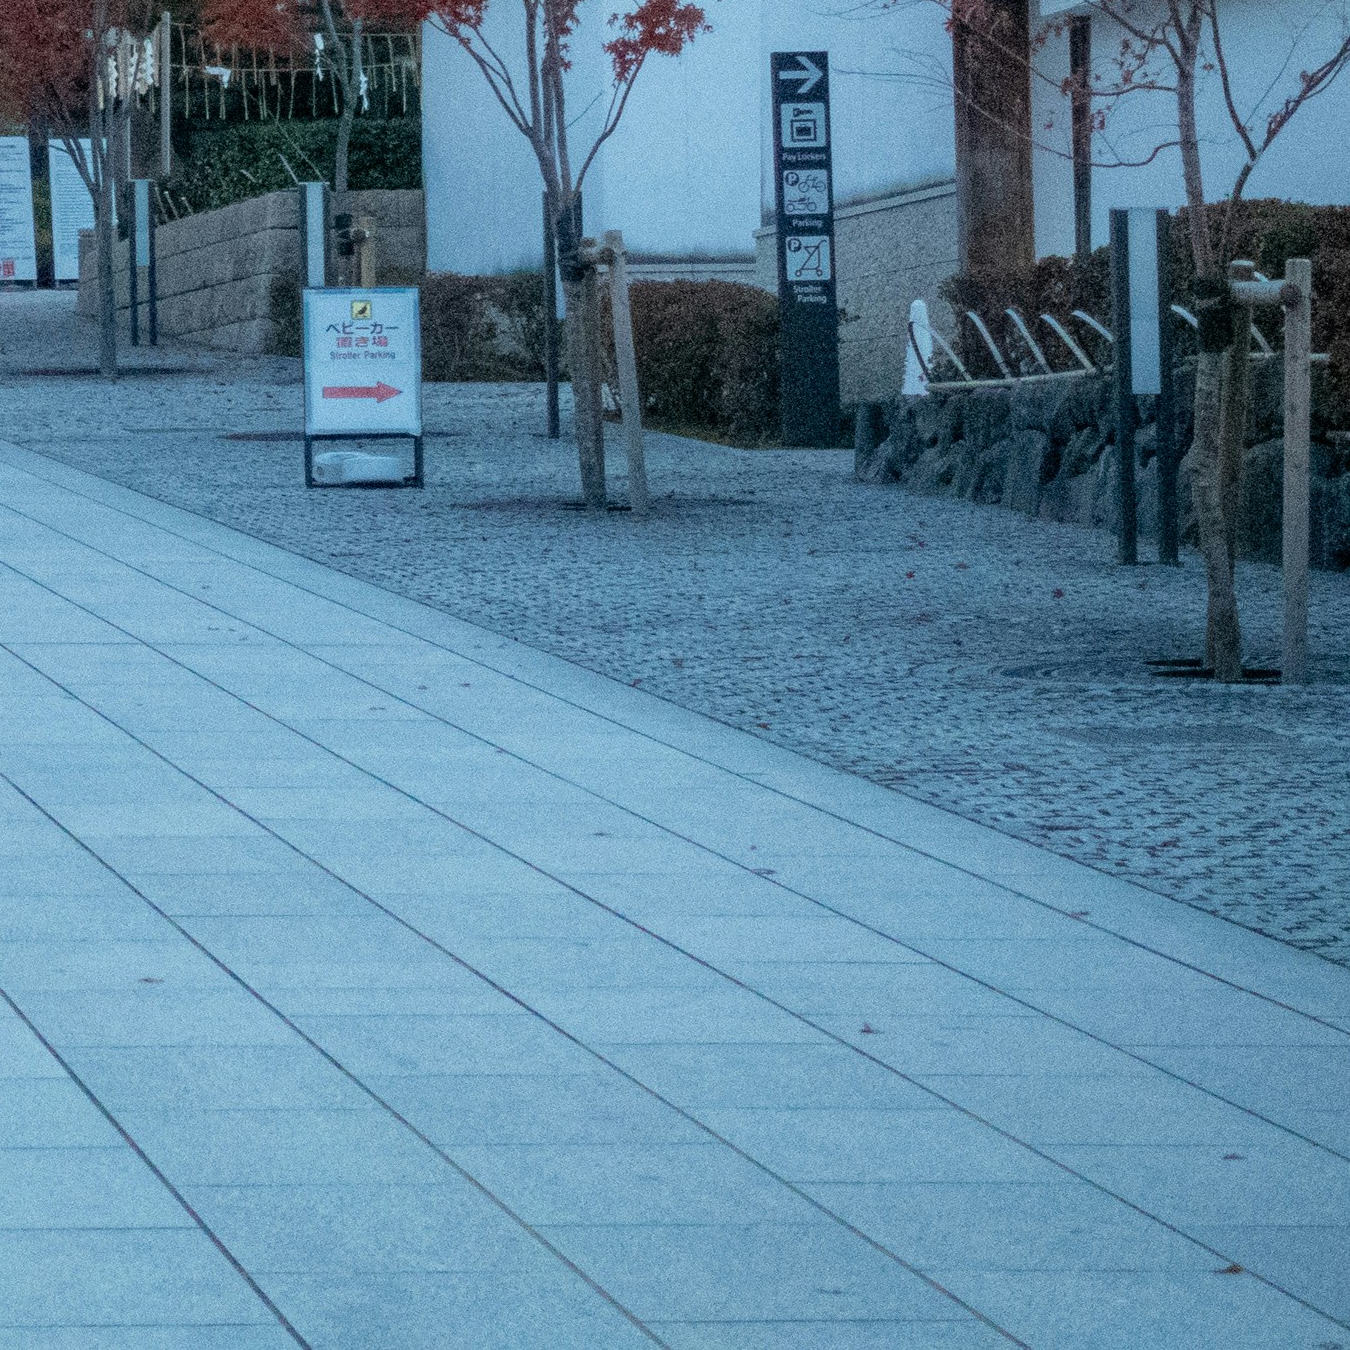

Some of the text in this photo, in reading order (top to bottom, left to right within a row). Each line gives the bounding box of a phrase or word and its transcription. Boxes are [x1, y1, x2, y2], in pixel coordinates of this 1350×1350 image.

[325, 321, 399, 334] ベビーカー
[336, 335, 388, 348] 置き場
[330, 351, 396, 360] Stroller Parking
